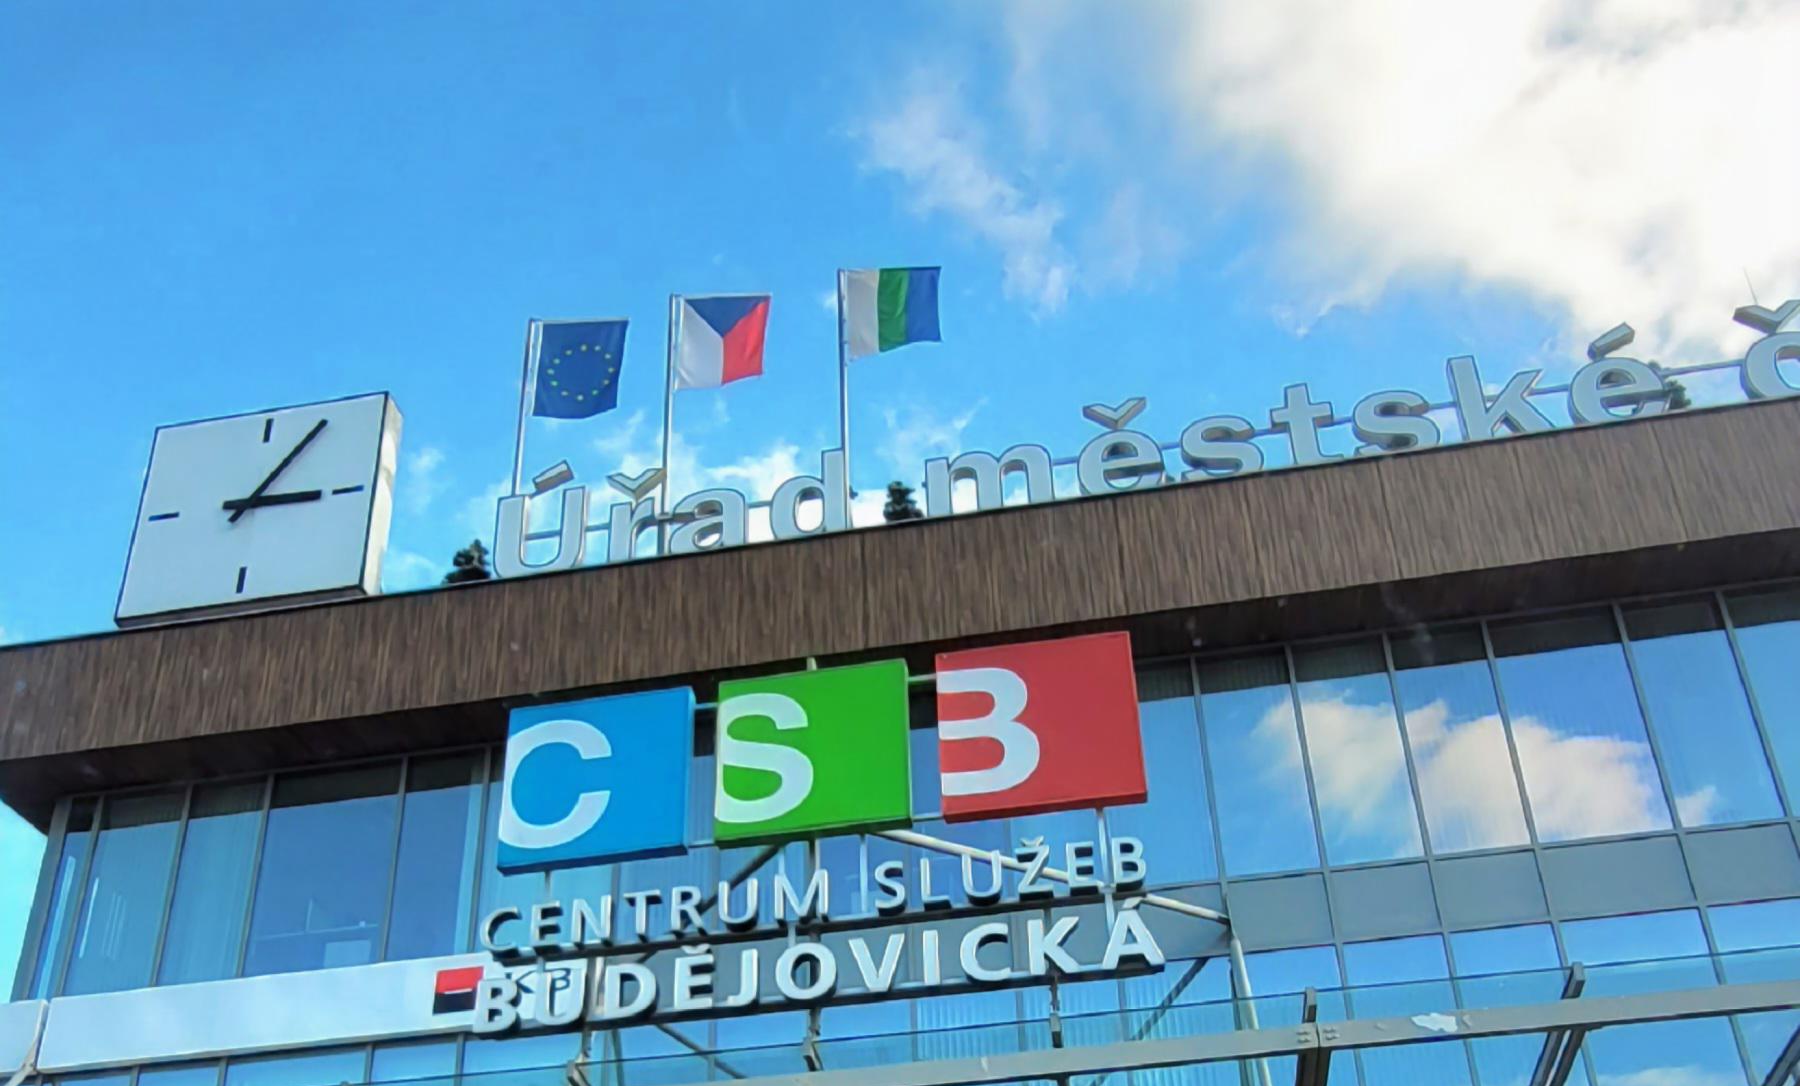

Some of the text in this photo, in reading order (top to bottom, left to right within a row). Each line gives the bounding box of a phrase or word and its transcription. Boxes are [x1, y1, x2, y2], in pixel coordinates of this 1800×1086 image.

[494, 447, 850, 579] Úřad
[925, 322, 1670, 511] městské
[480, 836, 1148, 953] CENTRUM SLUŽEB
[472, 896, 1166, 1034] BUDĚJOVICKÁ
